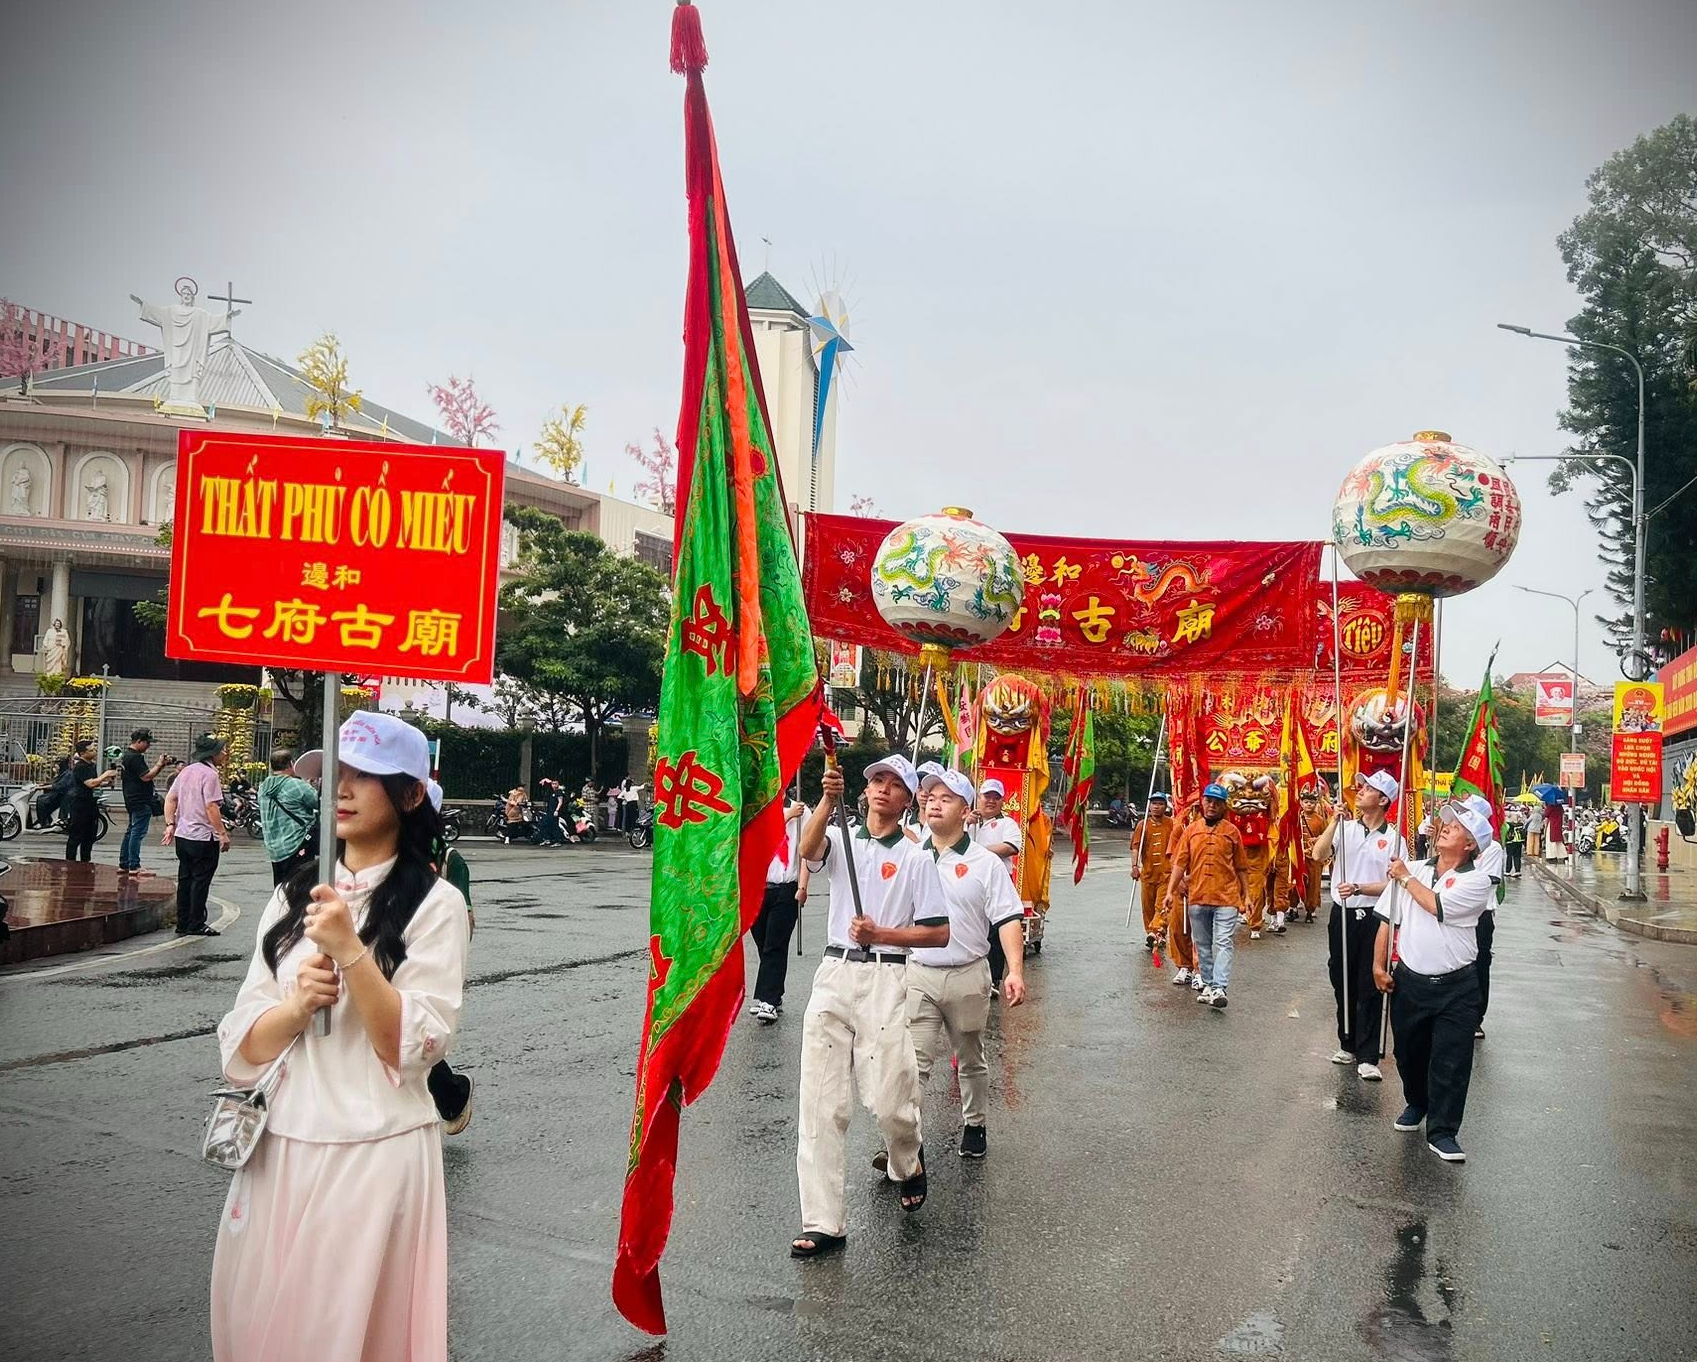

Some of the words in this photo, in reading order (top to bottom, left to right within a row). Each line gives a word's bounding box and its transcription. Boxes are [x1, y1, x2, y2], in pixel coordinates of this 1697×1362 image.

[201, 454, 278, 538] THẤT
[281, 467, 347, 545] PHỦ
[350, 460, 391, 548] CỔ
[396, 468, 477, 555] MIẾU
[301, 562, 361, 590] 邊和
[198, 593, 462, 656] 七府古廟
